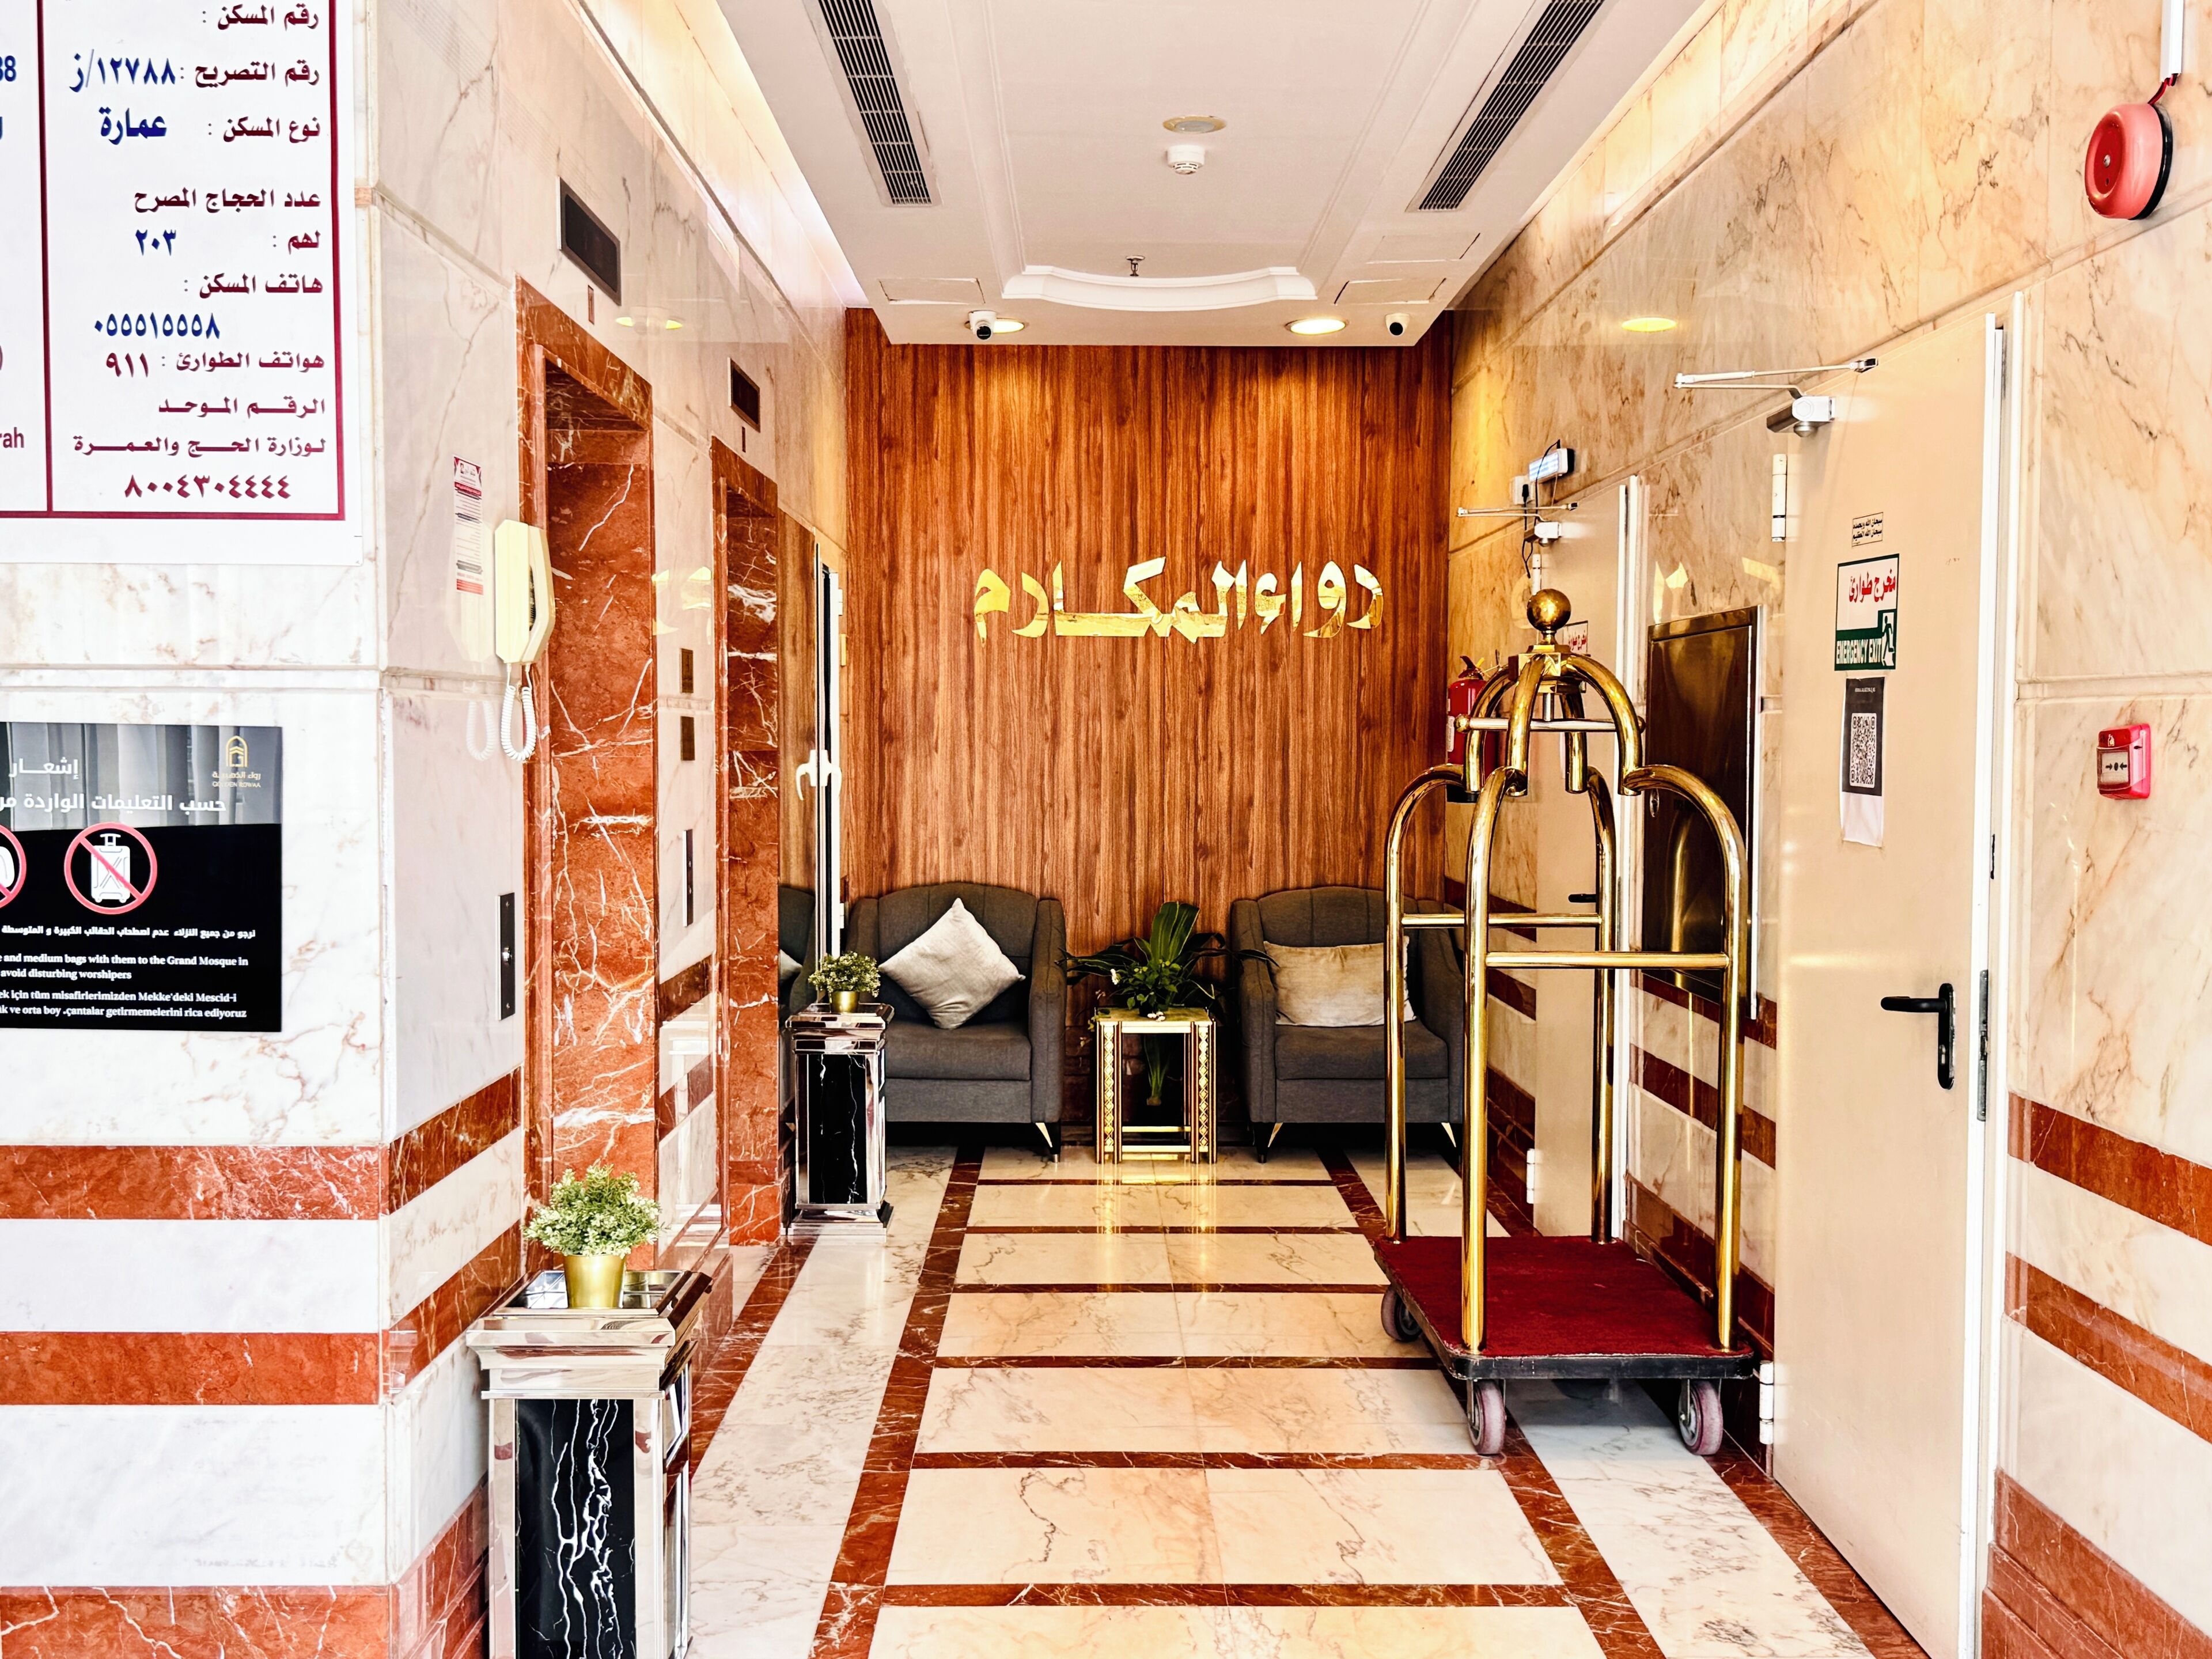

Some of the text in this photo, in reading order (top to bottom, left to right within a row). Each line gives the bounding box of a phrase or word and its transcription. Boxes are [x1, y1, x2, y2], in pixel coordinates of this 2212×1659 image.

[218, 5, 274, 30] المسكن
[284, 3, 318, 29] رقم
[196, 62, 275, 88] التصريح
[285, 60, 319, 85] رقم
[99, 107, 166, 145] عمارة
[224, 117, 279, 142] المسكن
[289, 118, 320, 143] نوع
[135, 188, 320, 213] عدد الحجاج المصرح
[135, 230, 176, 255] ٢٠٣
[288, 231, 320, 253] لهم
[200, 273, 255, 298] المسكن
[266, 274, 322, 293] هاتف
[107, 353, 148, 377] ٩١١
[177, 352, 249, 372] الطوارئ
[259, 351, 324, 372] هواتف
[159, 396, 324, 418] الرقم الموحد
[73, 436, 325, 457] لوزارة الحج والعمرة
[125, 475, 290, 498] ٨٠٠٤٣٠٤٤٤٤
[1849, 569, 1896, 603] مخرج طوارئ
[1836, 638, 1882, 664] EMERGENCY EXIT
[24, 793, 85, 813] الواردة
[92, 794, 173, 814] التعليمات
[179, 799, 226, 815] حسب
[152, 930, 169, 938] عدم
[222, 930, 235, 938] من
[3, 953, 22, 963] and
[23, 954, 63, 963] medium
[65, 955, 87, 965] bags
[88, 955, 110, 964] with
[111, 955, 137, 964] them
[138, 956, 148, 965] to
[149, 956, 166, 965] the
[166, 956, 198, 965] Grand
[199, 957, 237, 968] Mosque
[238, 957, 249, 966] in
[1, 968, 132, 981] avoid disturbing worshipers
[11, 990, 29, 1001] için
[31, 990, 50, 999] tüm
[138, 992, 194, 1002] Mekke'deki
[195, 993, 237, 1002] Mescid-i
[43, 1006, 62, 1017] boy
[105, 1007, 183, 1018] getirmemelerini
[184, 1008, 203, 1017] rica
[204, 1008, 247, 1020] ediyoruz
